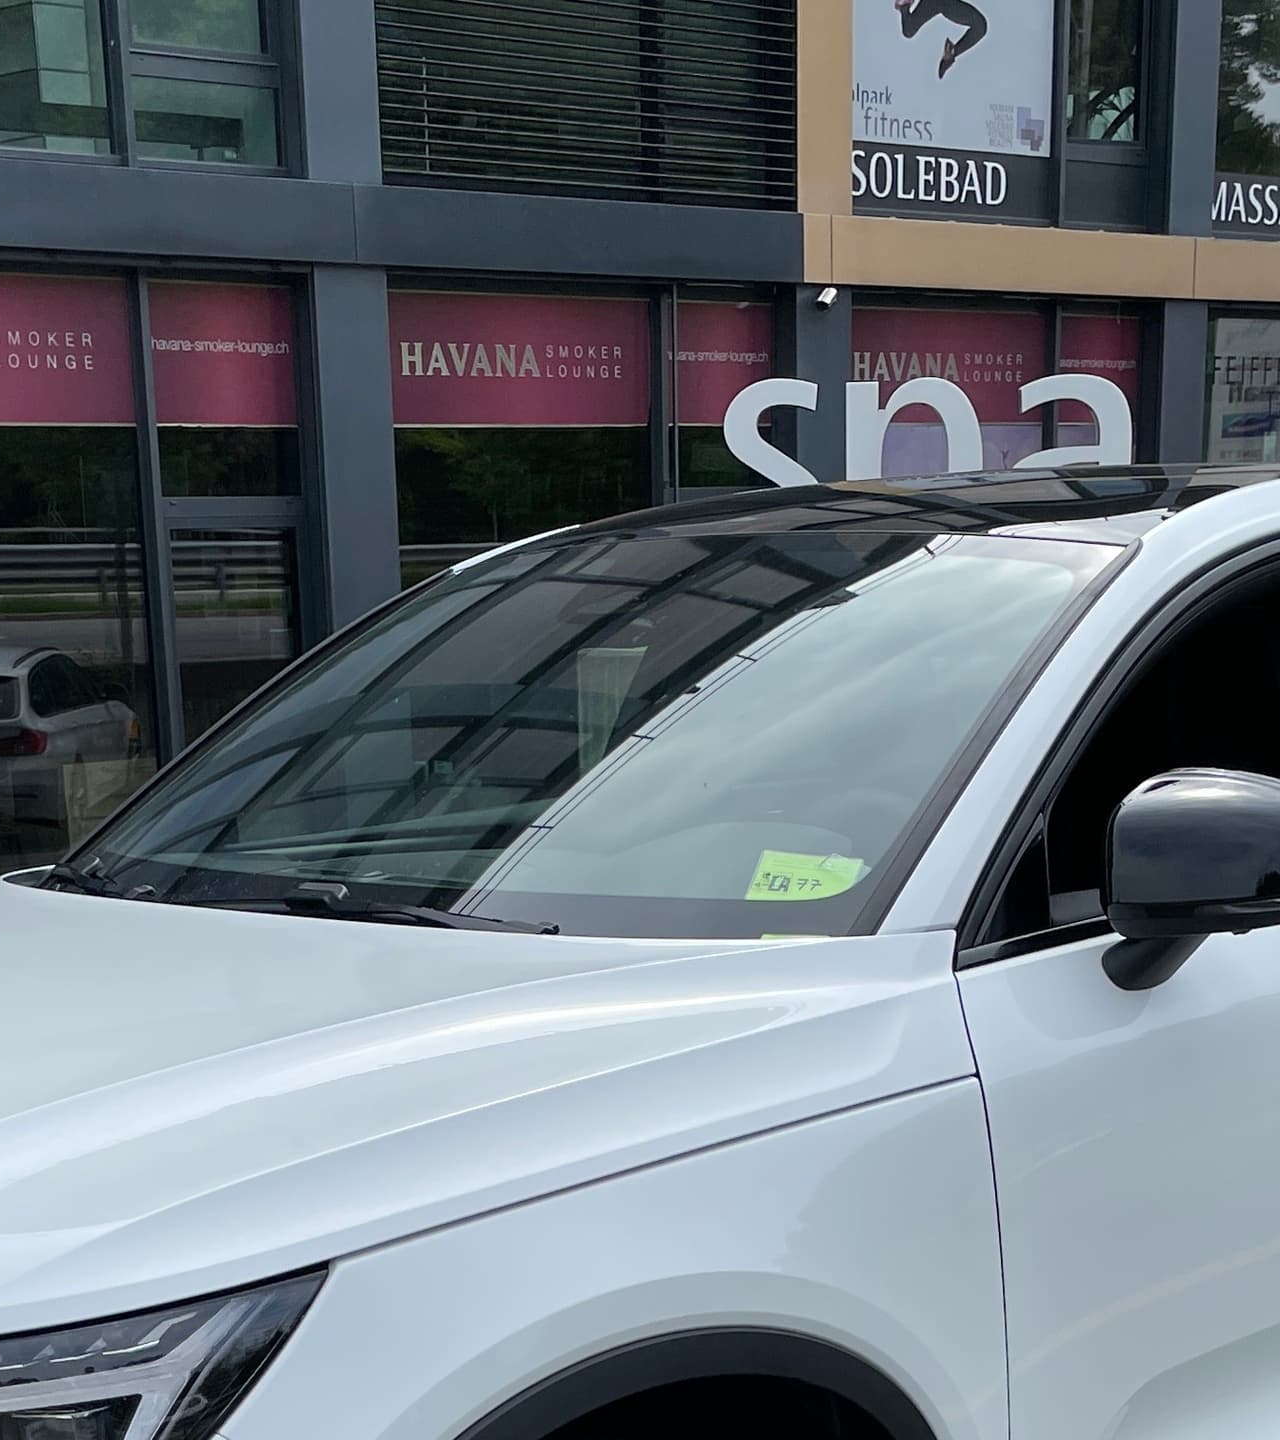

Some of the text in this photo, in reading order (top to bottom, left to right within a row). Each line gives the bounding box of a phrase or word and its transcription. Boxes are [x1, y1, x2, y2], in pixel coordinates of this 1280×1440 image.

[852, 83, 893, 109] lpark
[863, 106, 933, 141] fitness
[851, 149, 1008, 206] SOLEBAD
[151, 336, 290, 357] havana-smoker-lounge.ch
[400, 341, 623, 379] HAVANA SMOKER
[545, 364, 623, 379] LOUNGE
[853, 351, 1024, 383] HAVANA SMOKER
[964, 370, 1024, 383] LOUNGE
